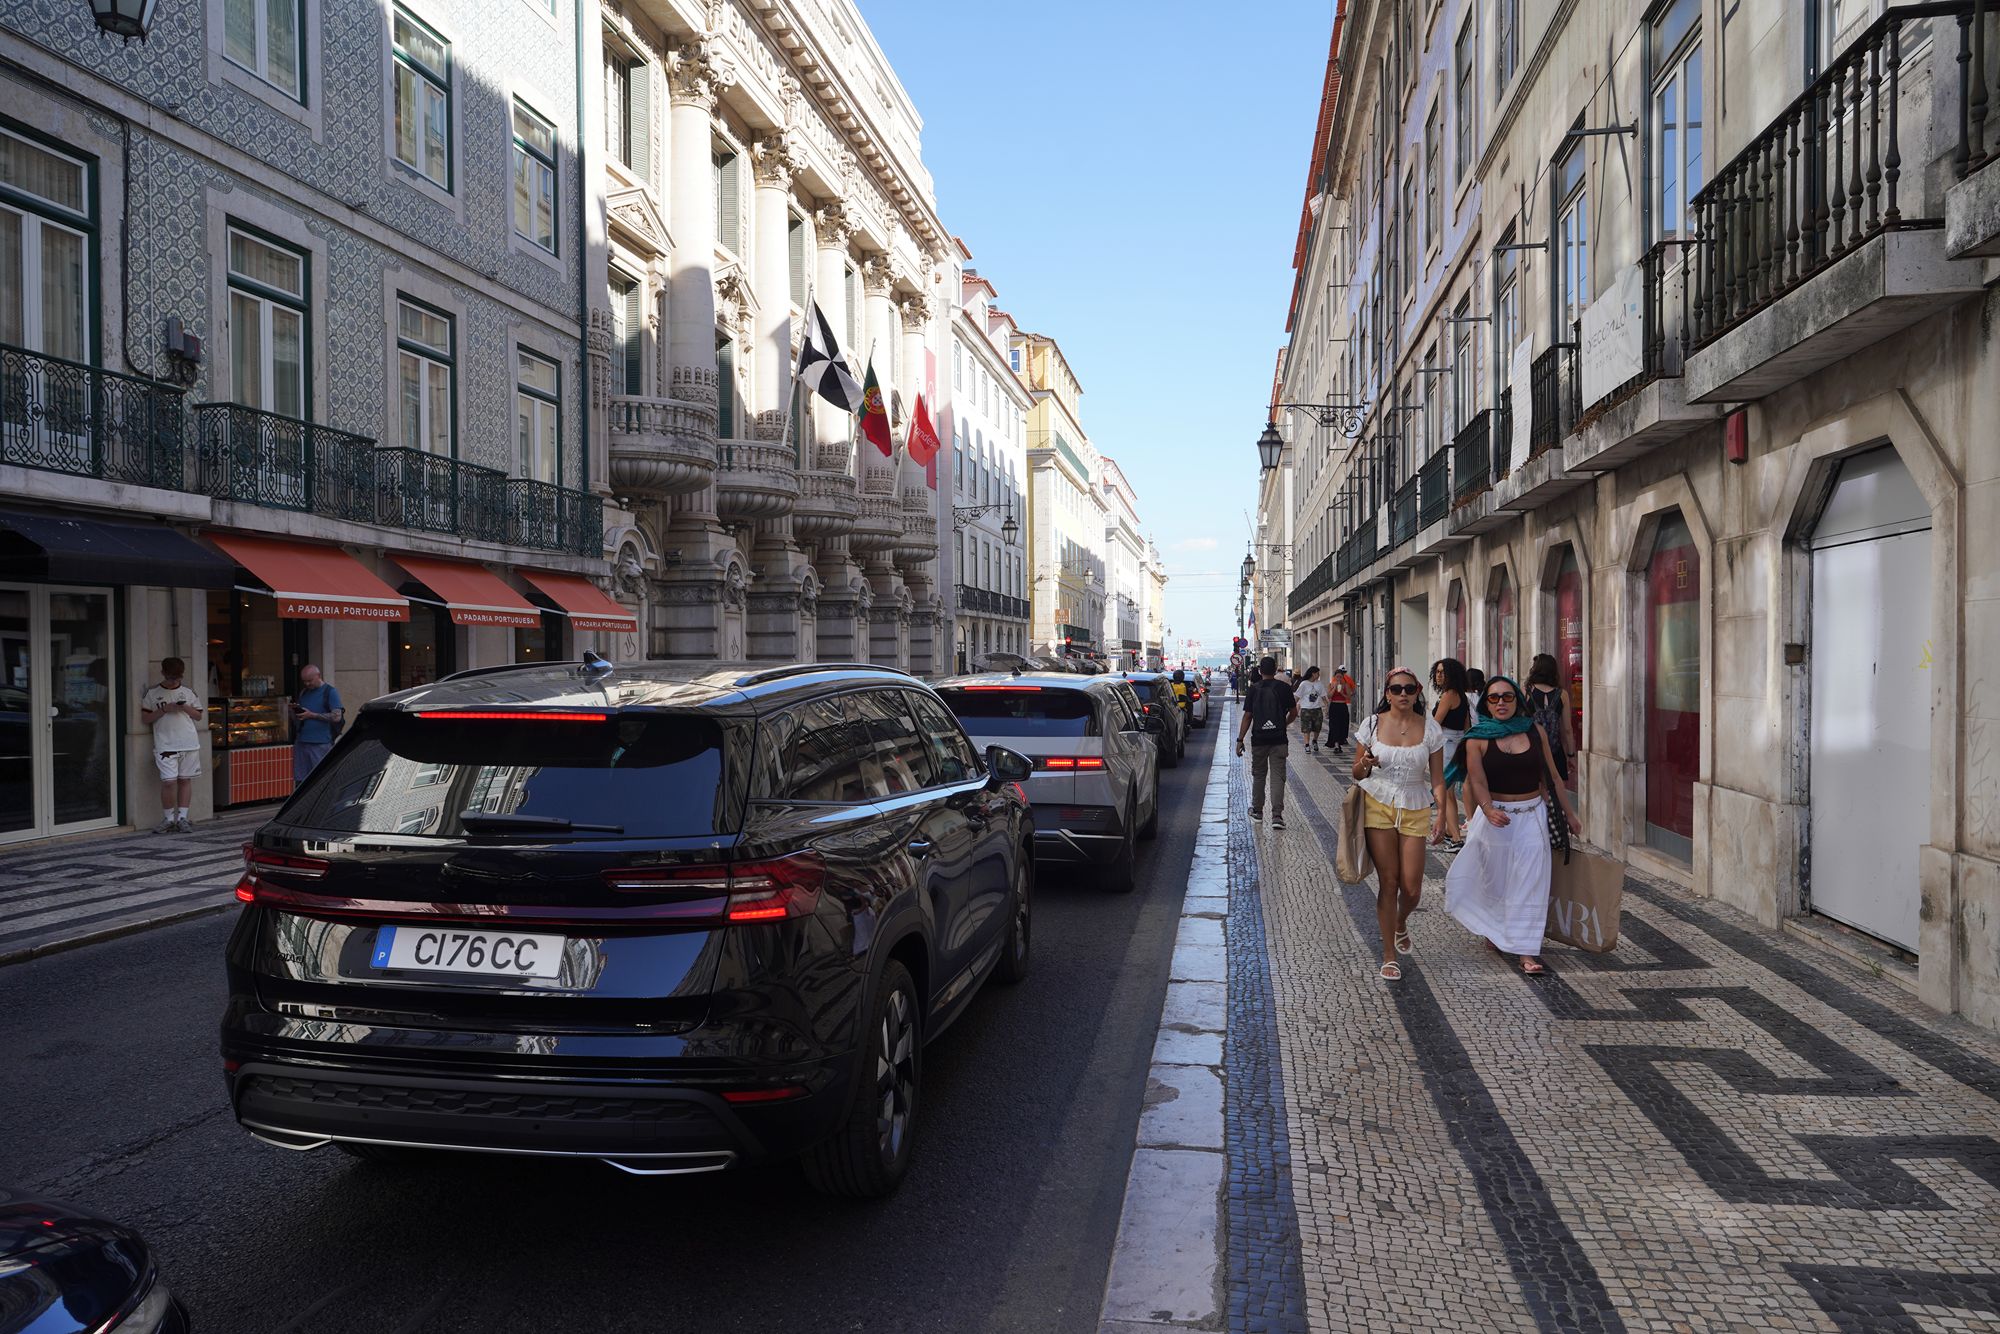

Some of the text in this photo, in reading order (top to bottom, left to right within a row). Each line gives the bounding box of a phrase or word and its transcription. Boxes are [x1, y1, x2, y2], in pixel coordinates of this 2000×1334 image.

[287, 604, 401, 617] A PADARIA PORTUGUESA
[463, 613, 493, 622] PADARIA
[494, 615, 535, 625] PORTUGUESA
[579, 620, 601, 628] PADARIA
[601, 621, 632, 629] PORTUGUESA
[378, 951, 386, 961] P
